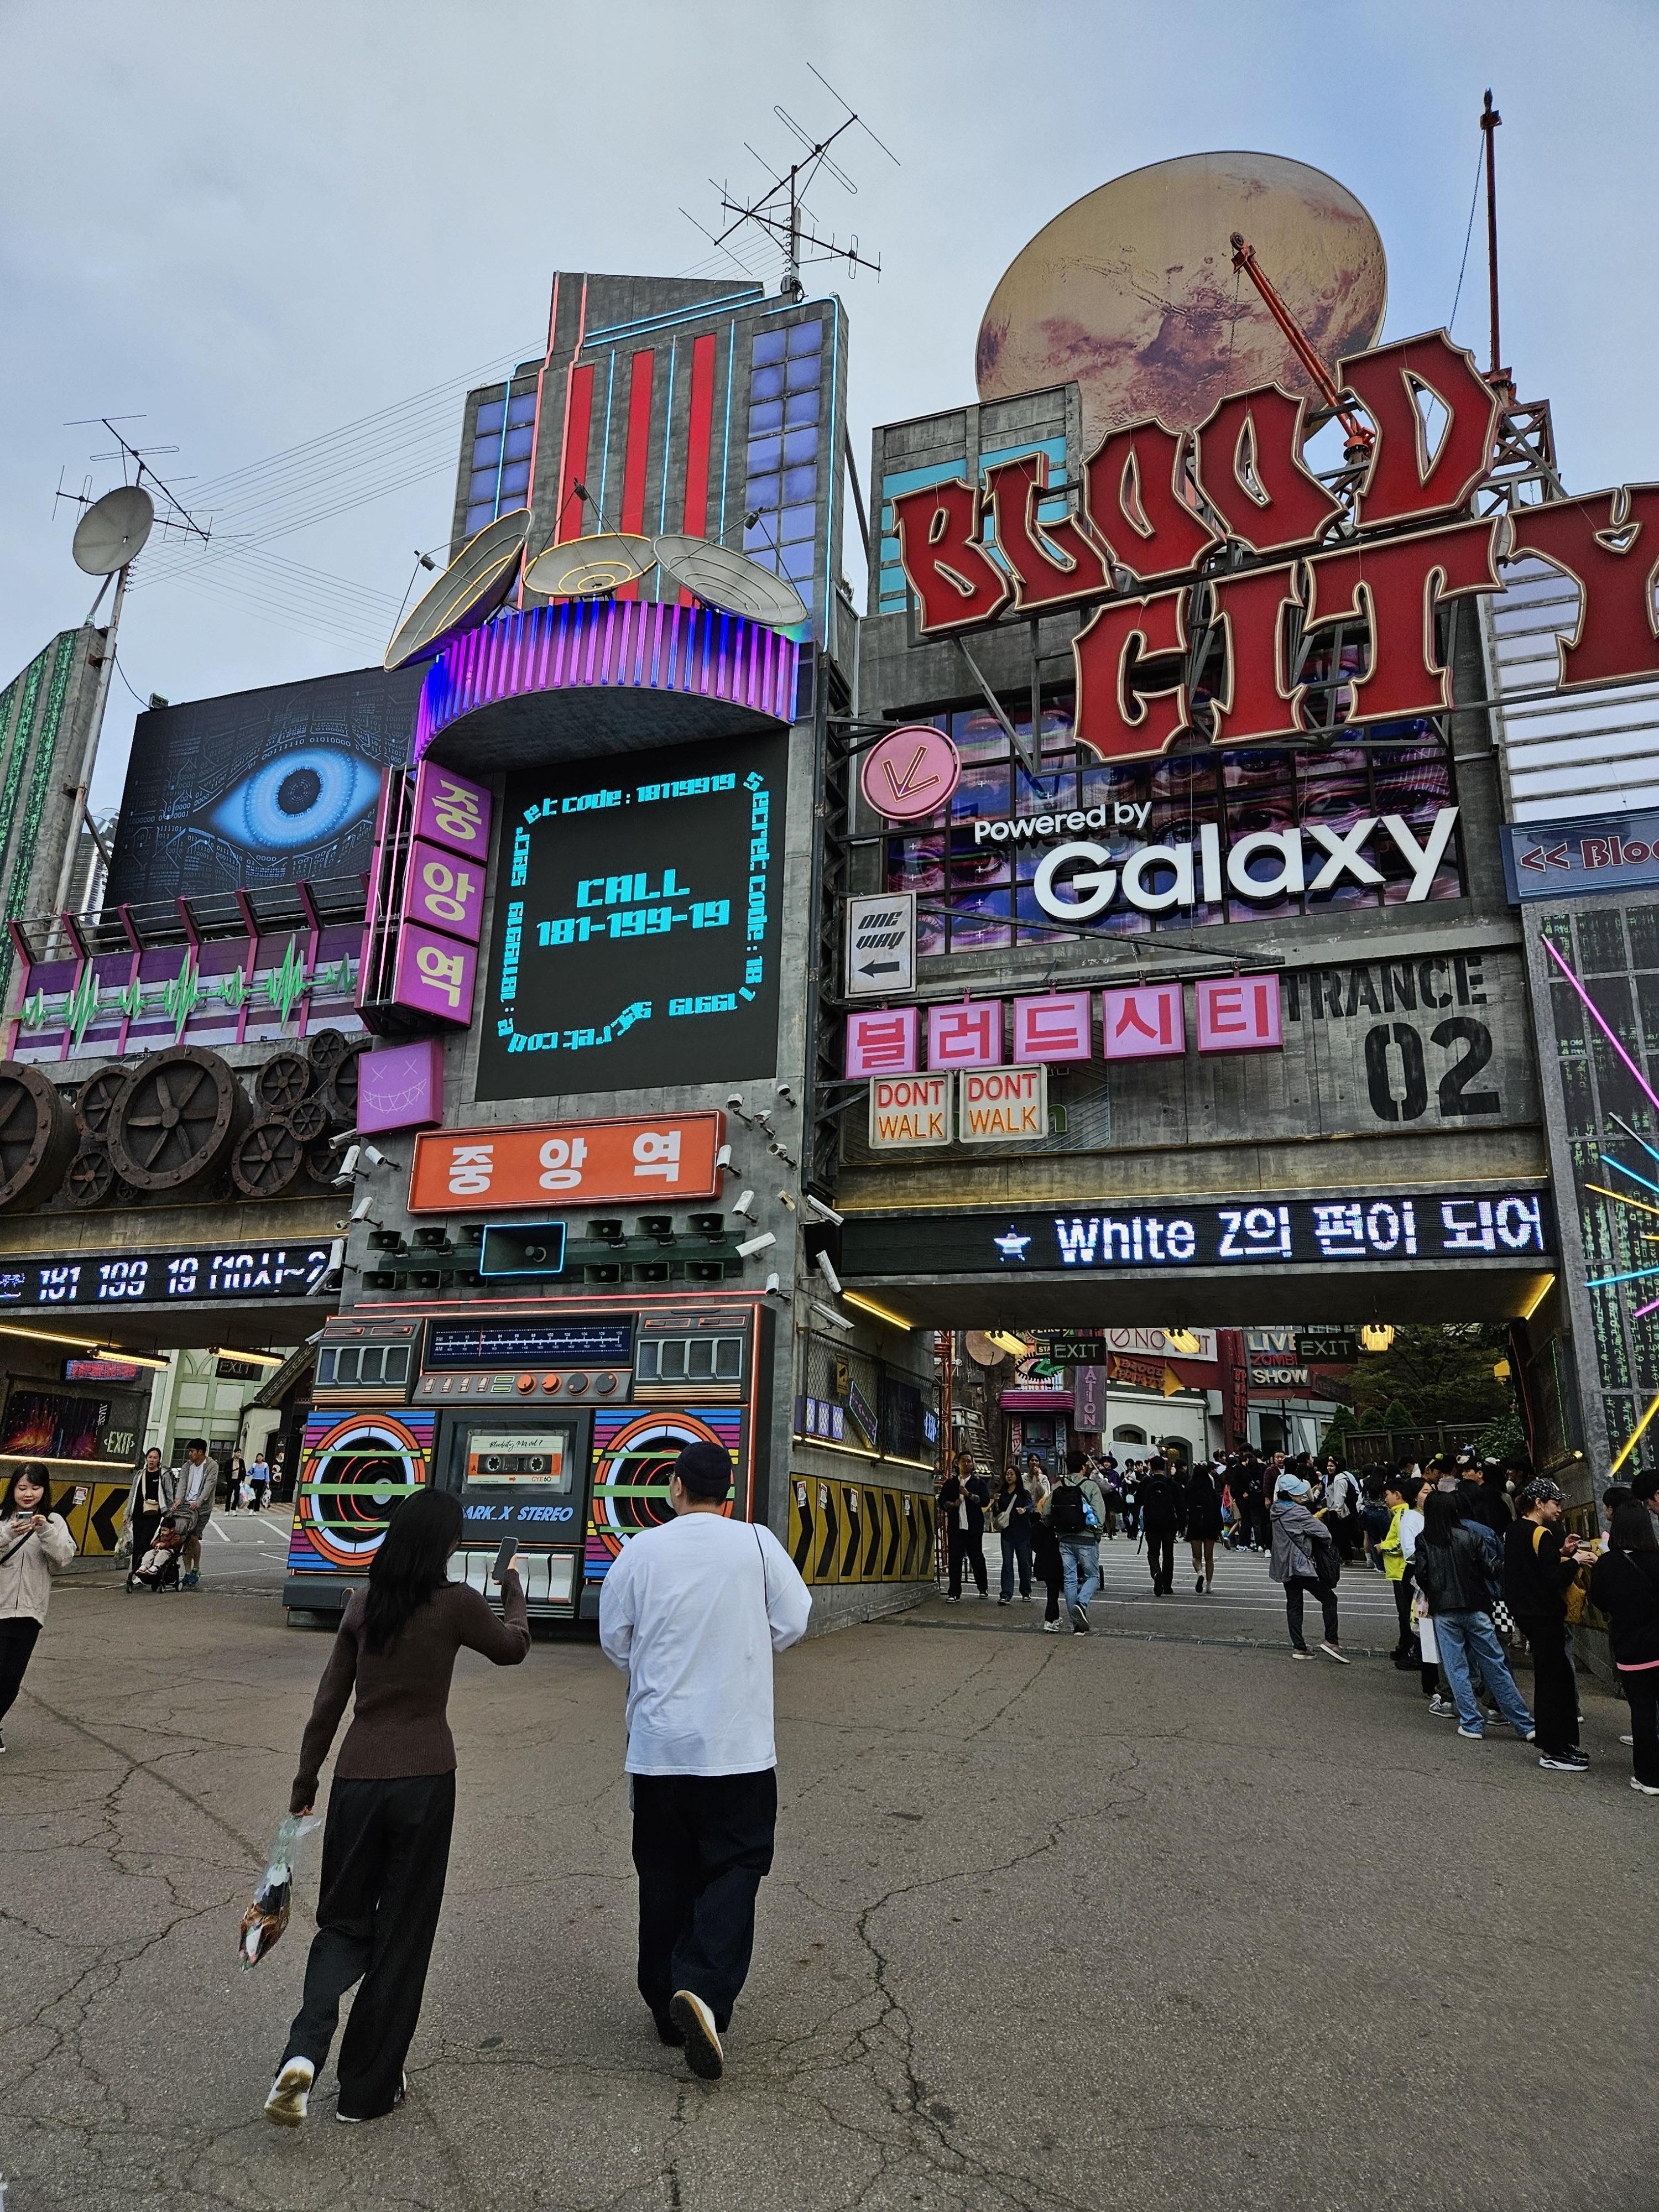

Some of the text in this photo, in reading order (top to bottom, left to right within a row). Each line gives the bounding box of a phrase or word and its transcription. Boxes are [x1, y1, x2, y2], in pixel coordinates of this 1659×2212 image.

[891, 327, 1503, 635] BLOOD
[1071, 482, 1659, 762] CITY
[974, 801, 1152, 844] Powered by
[1034, 806, 1459, 920] Galaxy
[1580, 836, 1659, 869] Blo
[576, 869, 690, 907] CALL
[536, 899, 731, 946] 181-199-19
[858, 911, 903, 930] ONE
[855, 931, 906, 950] WAY
[1279, 954, 1488, 1022] TRANCE
[857, 985, 1269, 1070] 블러드시티
[1364, 1016, 1501, 1122] 02
[877, 1080, 945, 1108] DONT
[968, 1073, 1037, 1102] DONT
[878, 1112, 943, 1141] WALK
[968, 1105, 1037, 1135] WALK
[1054, 1215, 1195, 1263] White
[1055, 1344, 1100, 1358] EXIT
[1135, 1327, 1166, 1349] NO
[1301, 1340, 1350, 1355] EXIT
[1251, 1354, 1298, 1366] ZOMBI
[1253, 1369, 1308, 1384] SHOW
[1083, 1365, 1097, 1426] ATION
[465, 1505, 574, 1522] ARK_X STEREO
